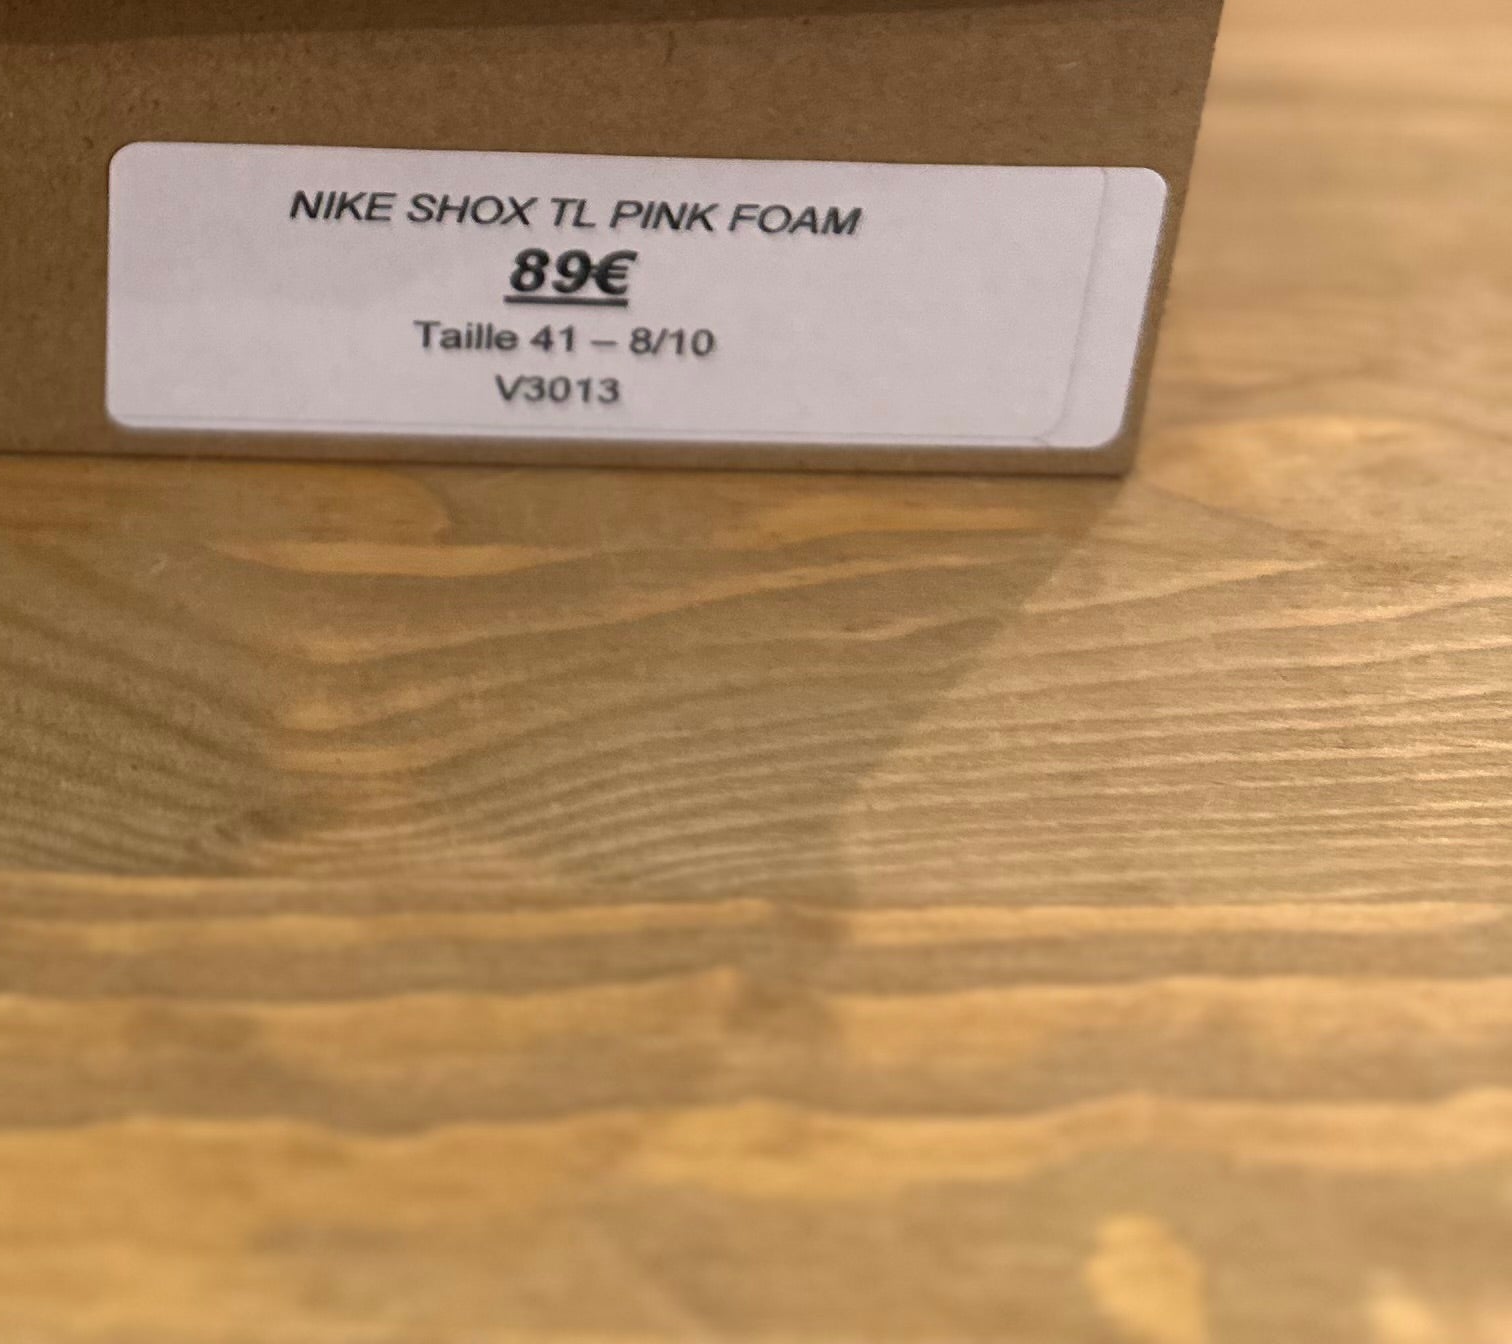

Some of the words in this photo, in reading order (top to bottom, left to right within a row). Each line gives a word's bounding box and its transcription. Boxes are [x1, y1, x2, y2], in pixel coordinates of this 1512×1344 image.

[289, 190, 397, 223] NIKE
[405, 192, 539, 229] SHOX
[550, 197, 597, 230] TL
[608, 199, 720, 234] PINK
[727, 203, 864, 238] FOAM
[506, 247, 638, 297] 89€
[412, 319, 519, 352] Taille
[529, 324, 576, 354] 41
[628, 326, 718, 360] 8/10
[494, 373, 621, 406] V3013
